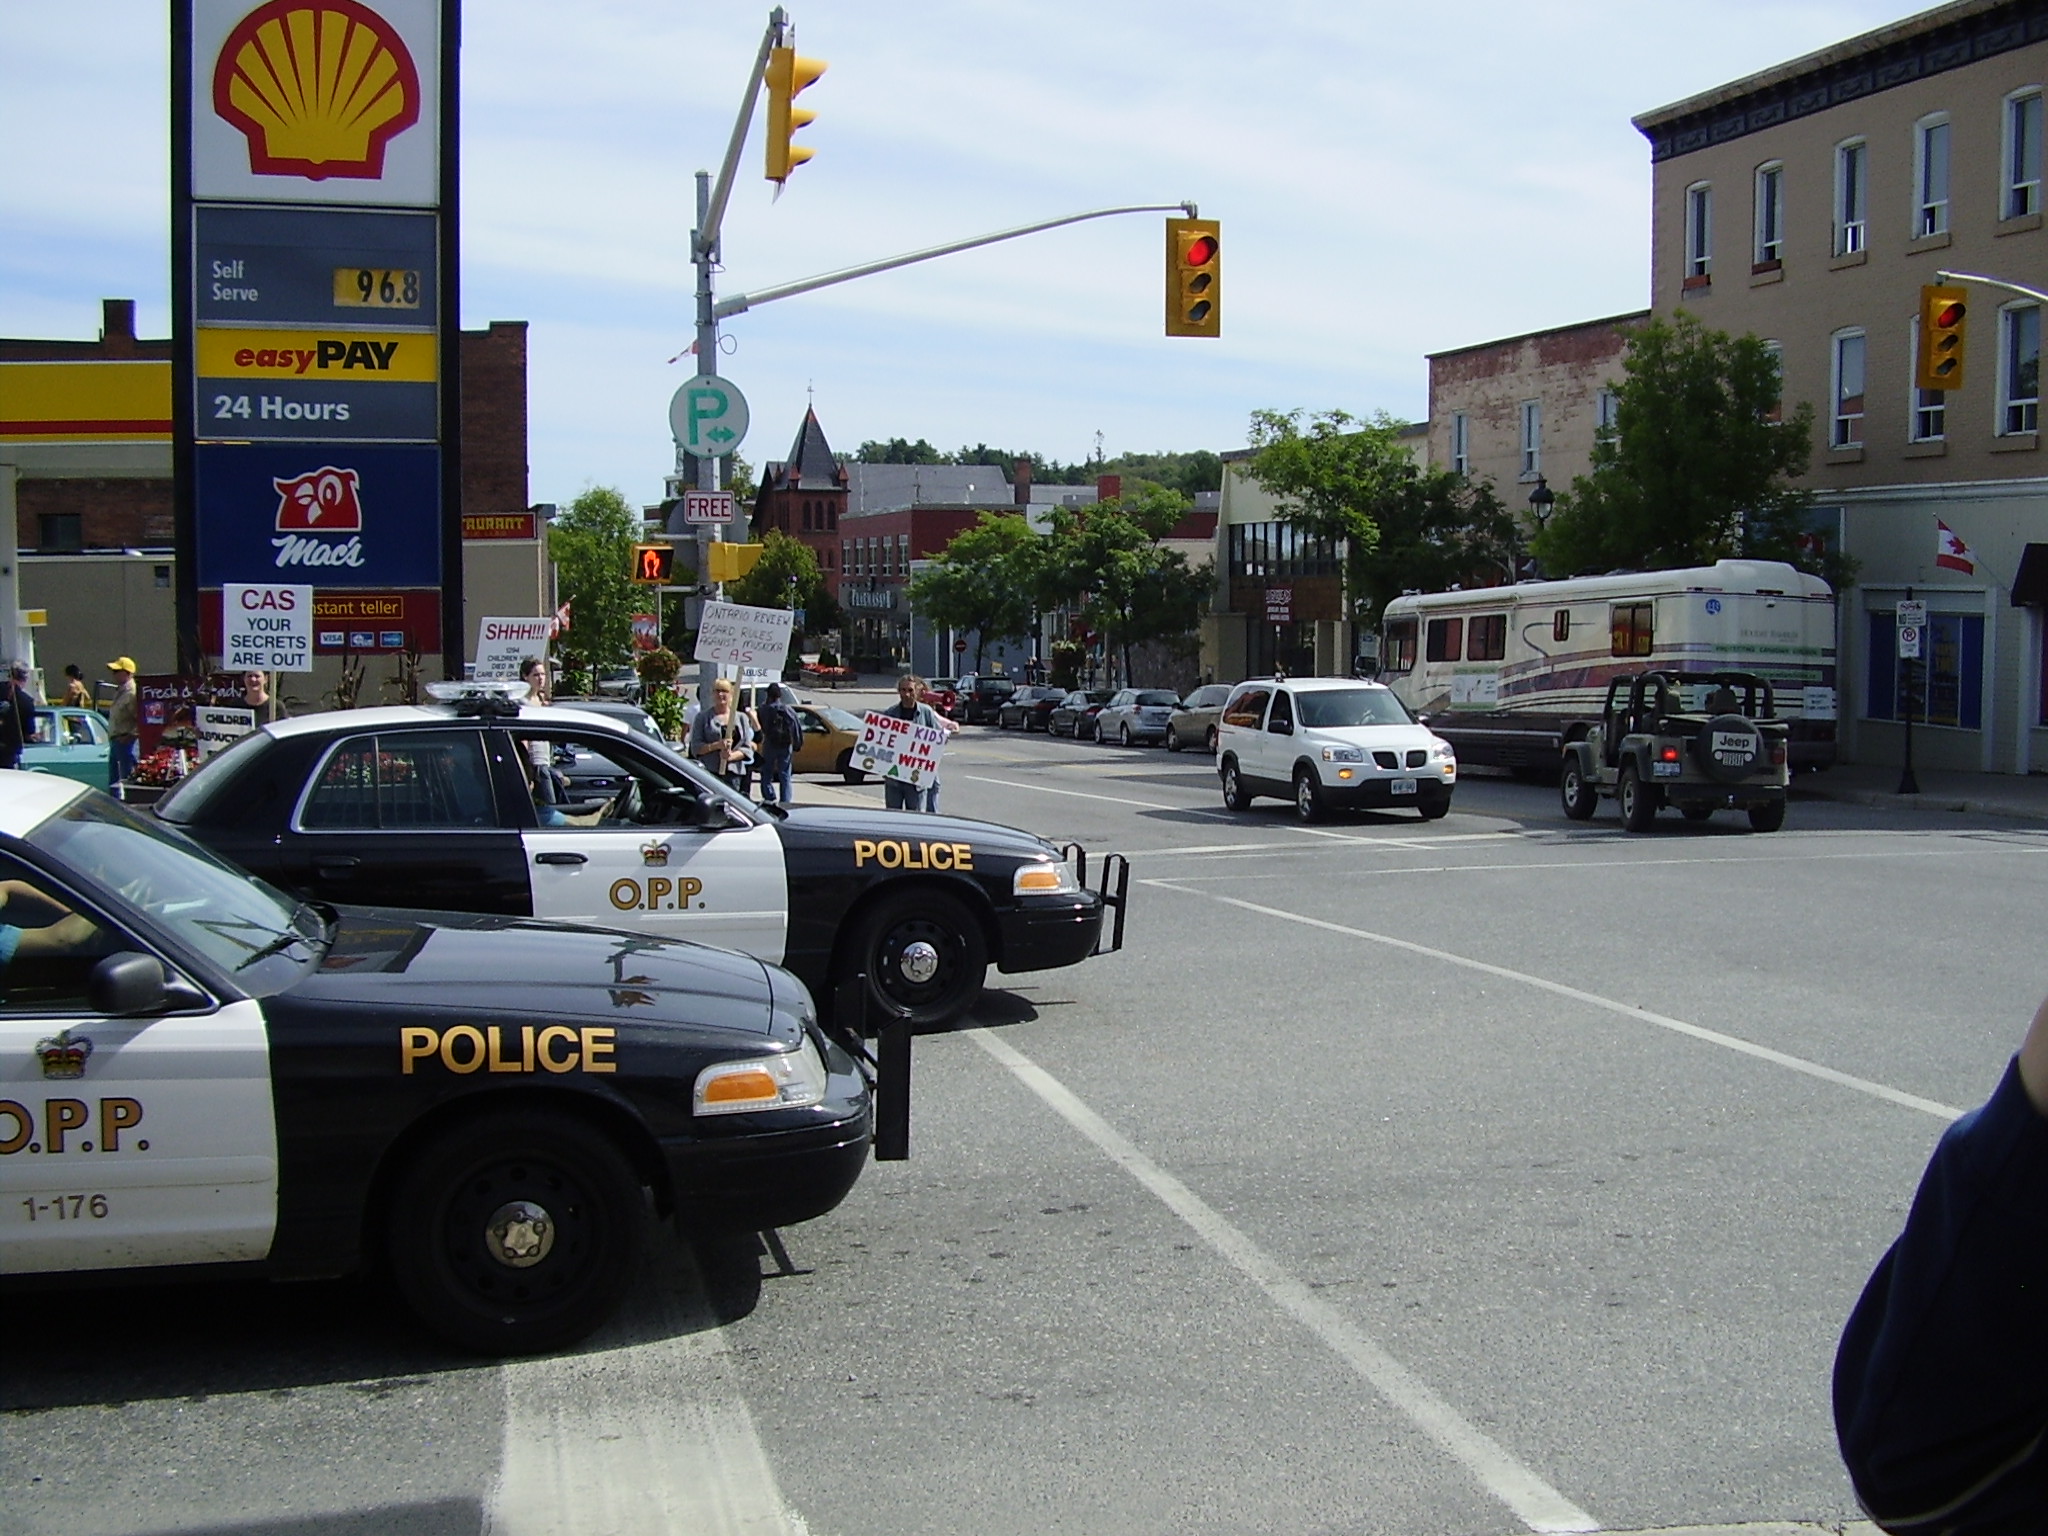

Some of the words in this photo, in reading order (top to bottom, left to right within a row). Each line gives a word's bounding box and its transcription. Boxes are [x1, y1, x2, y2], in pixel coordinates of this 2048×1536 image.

[212, 260, 244, 279] Self
[212, 283, 259, 301] Serve
[357, 270, 418, 304] 96.8
[234, 340, 399, 374] easyPAY
[214, 395, 251, 419] 24
[260, 396, 350, 420] Hours
[687, 388, 729, 445] P
[688, 498, 731, 517] FREE
[463, 517, 525, 530] AURANT
[271, 534, 365, 567] Mac's
[241, 589, 295, 611] CAS
[360, 600, 398, 615] teller
[247, 618, 291, 631] YOUR
[705, 605, 750, 622] ONTARIO
[753, 611, 791, 626] REVIEW
[485, 623, 546, 641] SHHH!!!
[701, 622, 736, 637] BOARD
[741, 627, 774, 641] RULES
[231, 635, 306, 649] SECRETS
[232, 652, 264, 666] ARE
[271, 653, 305, 667] OUT
[487, 654, 519, 662] CHILDREN
[142, 683, 178, 699] Fresh
[205, 714, 252, 726] CHILDREN
[864, 713, 911, 735] MORE
[864, 728, 897, 748] DIE
[910, 741, 931, 757] IN
[1719, 735, 1750, 748] Jeep
[856, 743, 895, 763] CARE
[898, 753, 936, 772] WITH
[854, 839, 974, 871] POLICE
[609, 877, 706, 910] O.P.P.
[401, 1025, 617, 1075] POLICE
[23, 1195, 109, 1222] 1-176
